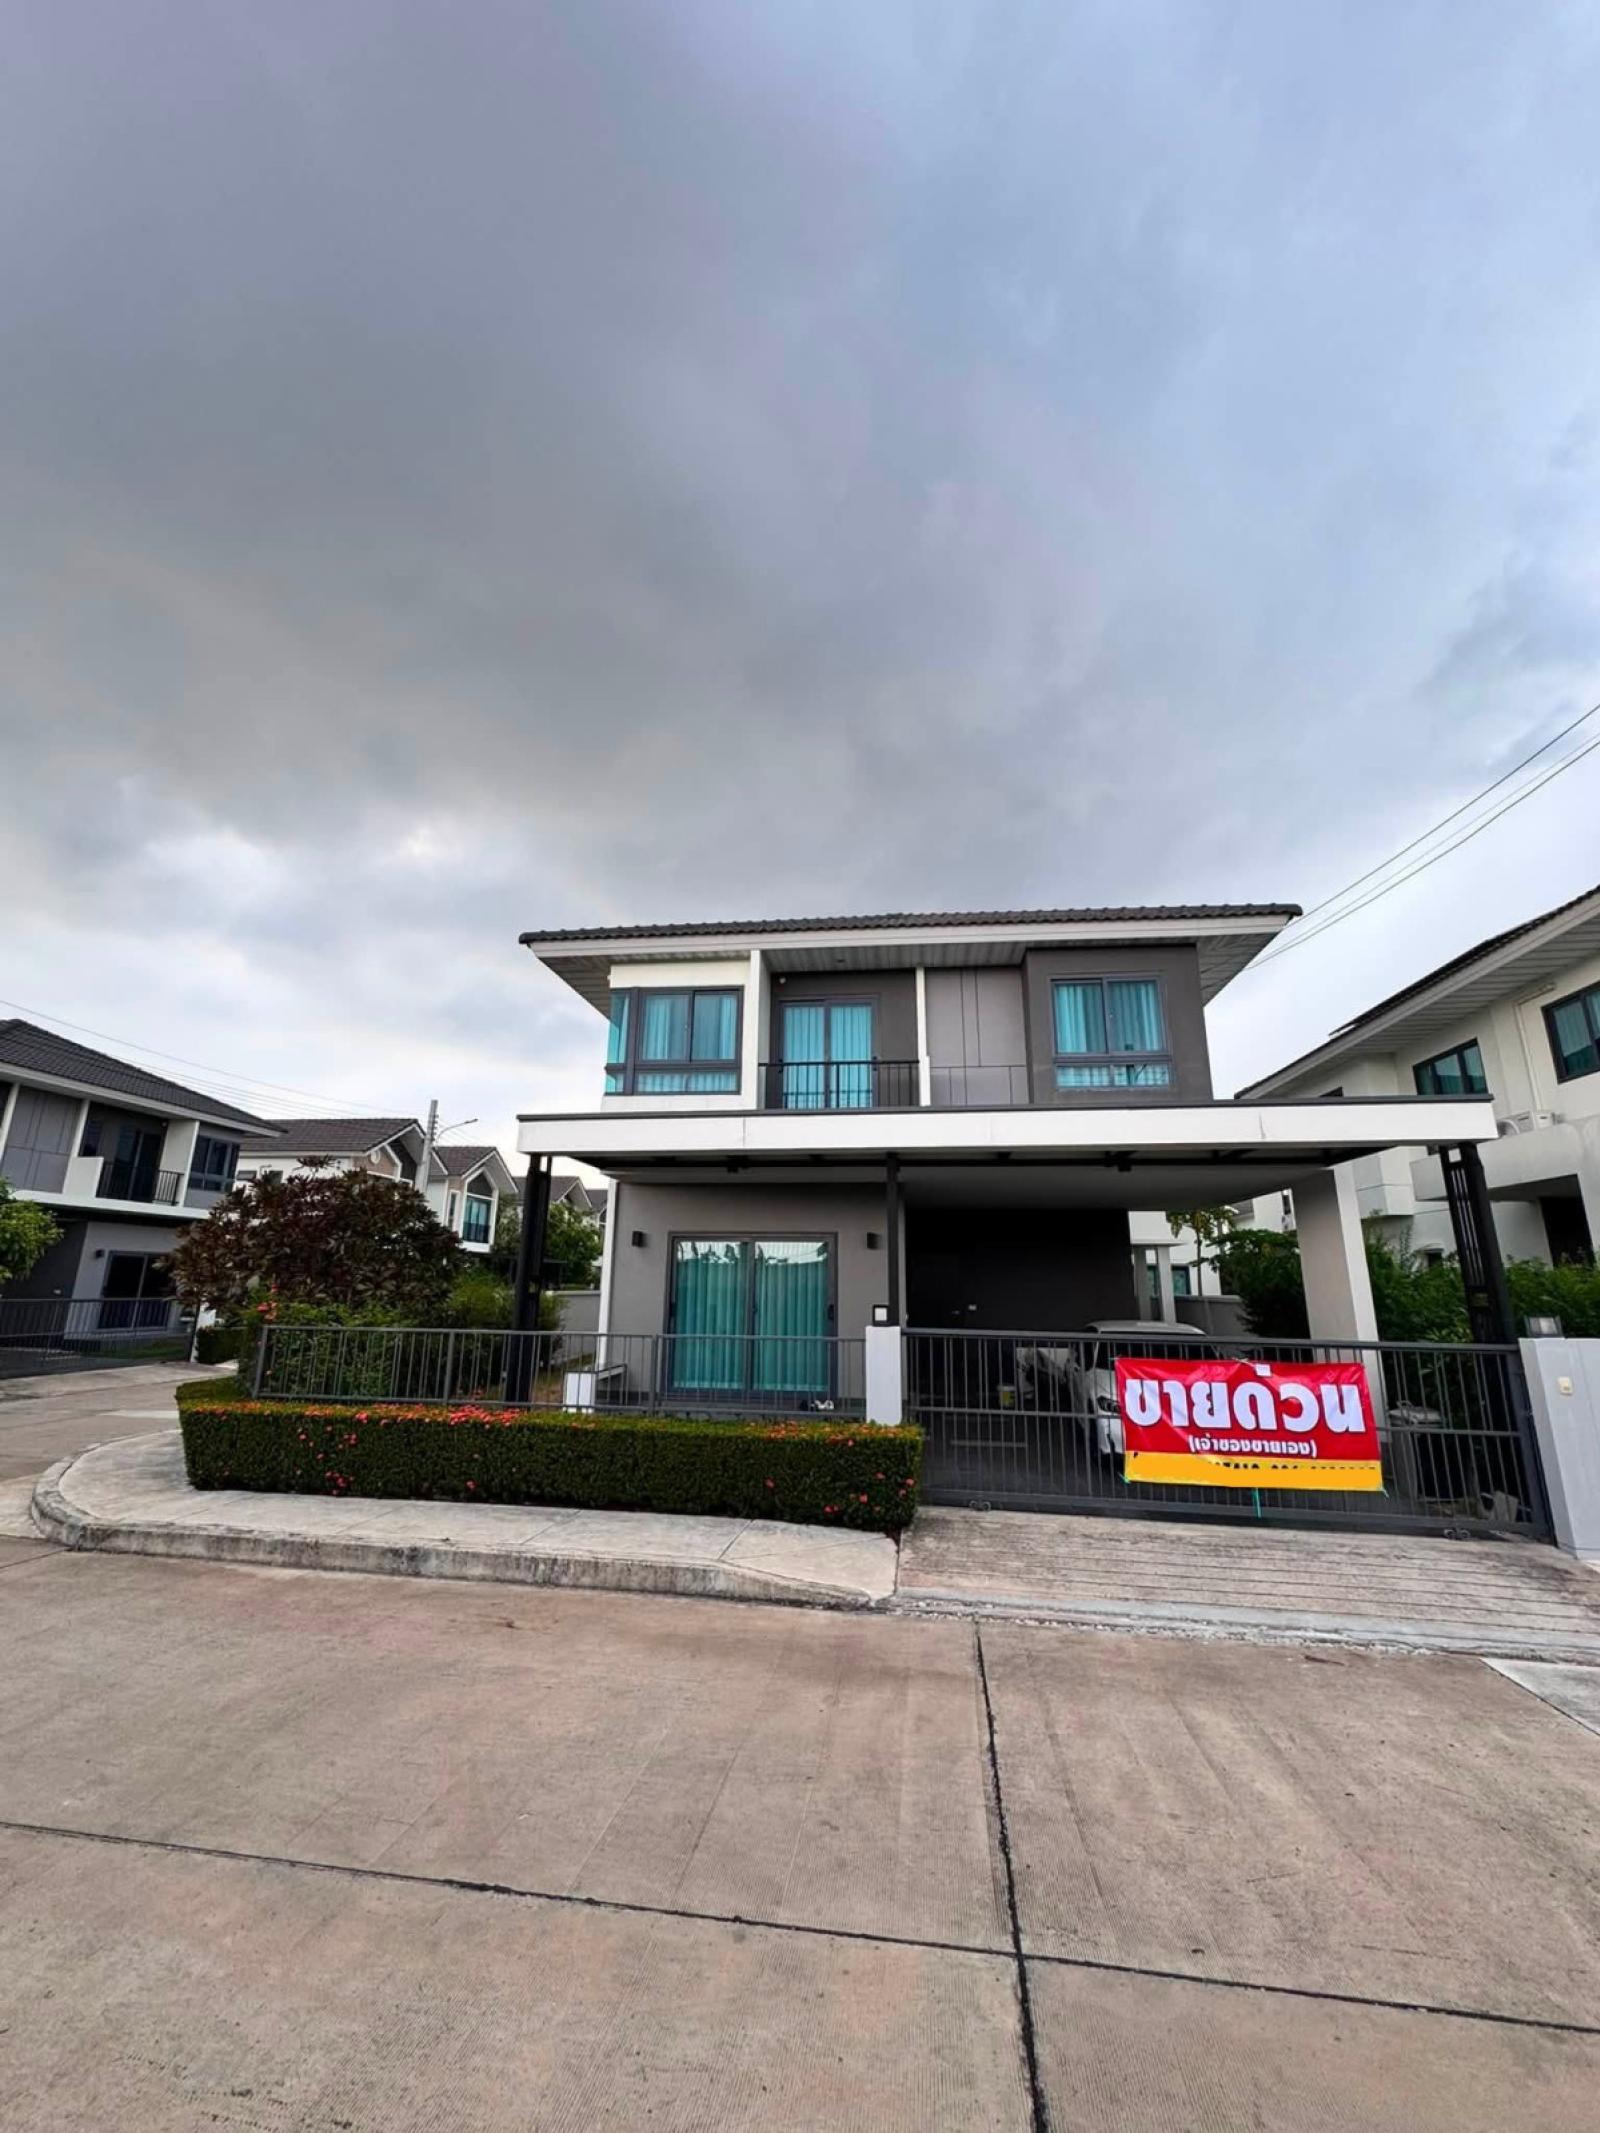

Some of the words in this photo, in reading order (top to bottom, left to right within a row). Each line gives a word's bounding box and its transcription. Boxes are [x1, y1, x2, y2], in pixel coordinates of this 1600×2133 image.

[1125, 1364, 1366, 1433] ขายด่วน
[1189, 1434, 1317, 1457] (เจ้าของขายเอง)
